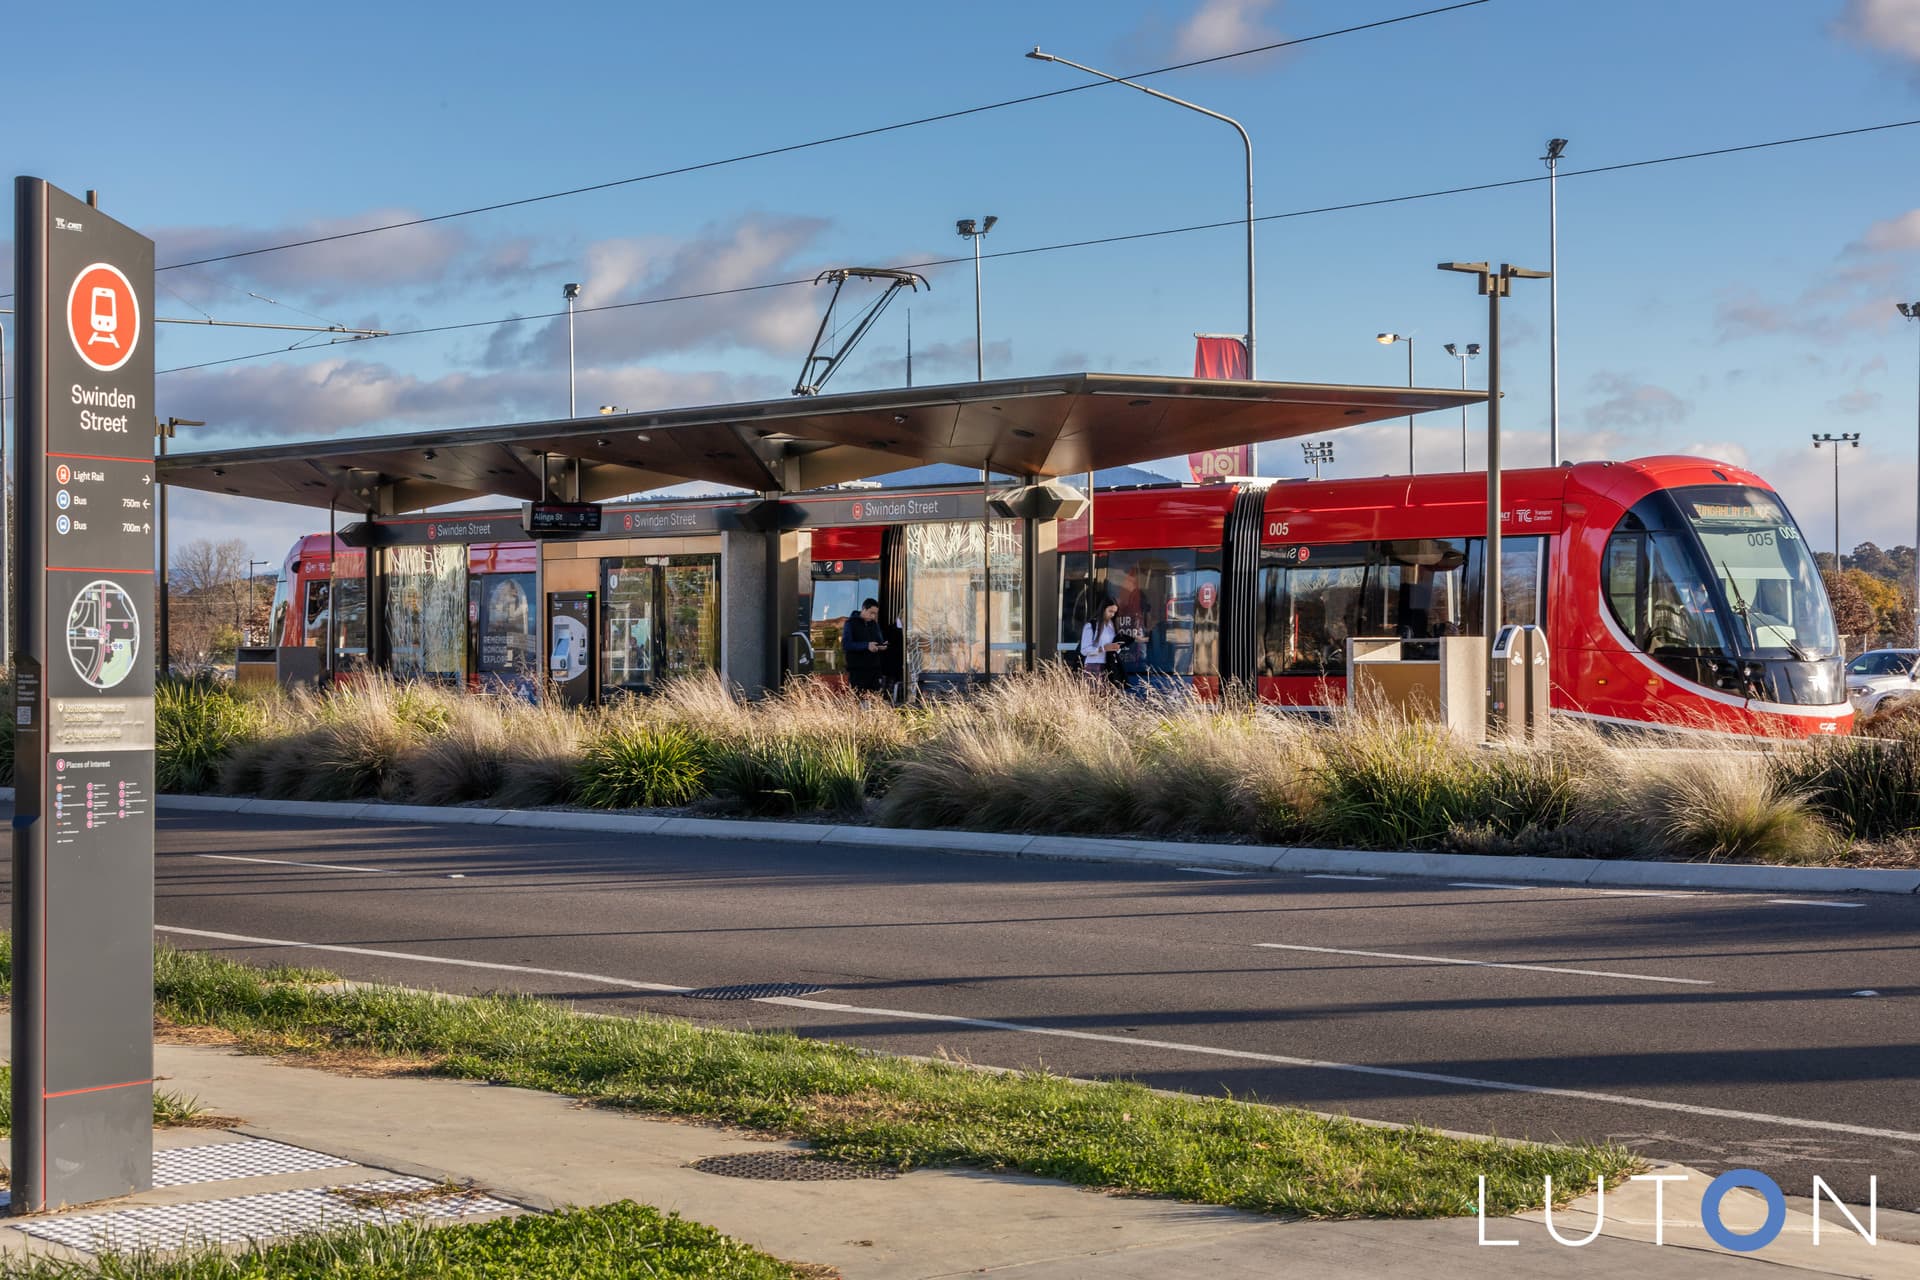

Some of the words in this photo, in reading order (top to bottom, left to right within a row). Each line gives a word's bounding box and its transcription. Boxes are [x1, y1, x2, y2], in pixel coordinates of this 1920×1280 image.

[71, 384, 136, 409] Swinden
[80, 409, 128, 433] Street
[73, 471, 90, 482] Light
[91, 472, 104, 481] Rail
[73, 495, 88, 505] Bus
[122, 498, 141, 508] 750m
[863, 502, 906, 516] Swinden
[908, 500, 938, 514] Street
[534, 512, 554, 522] Alinga
[555, 512, 563, 521] St
[579, 513, 585, 521] 5
[634, 514, 669, 528] Swinden
[671, 512, 697, 526] Street
[73, 520, 88, 531] Bus
[122, 522, 141, 533] 700m
[437, 524, 468, 537] Swinden
[468, 522, 491, 535] Street
[1269, 522, 1289, 536] 005
[1778, 526, 1800, 540] 005
[1747, 533, 1774, 547] 005
[66, 761, 84, 769] Places
[90, 760, 111, 768] Interest
